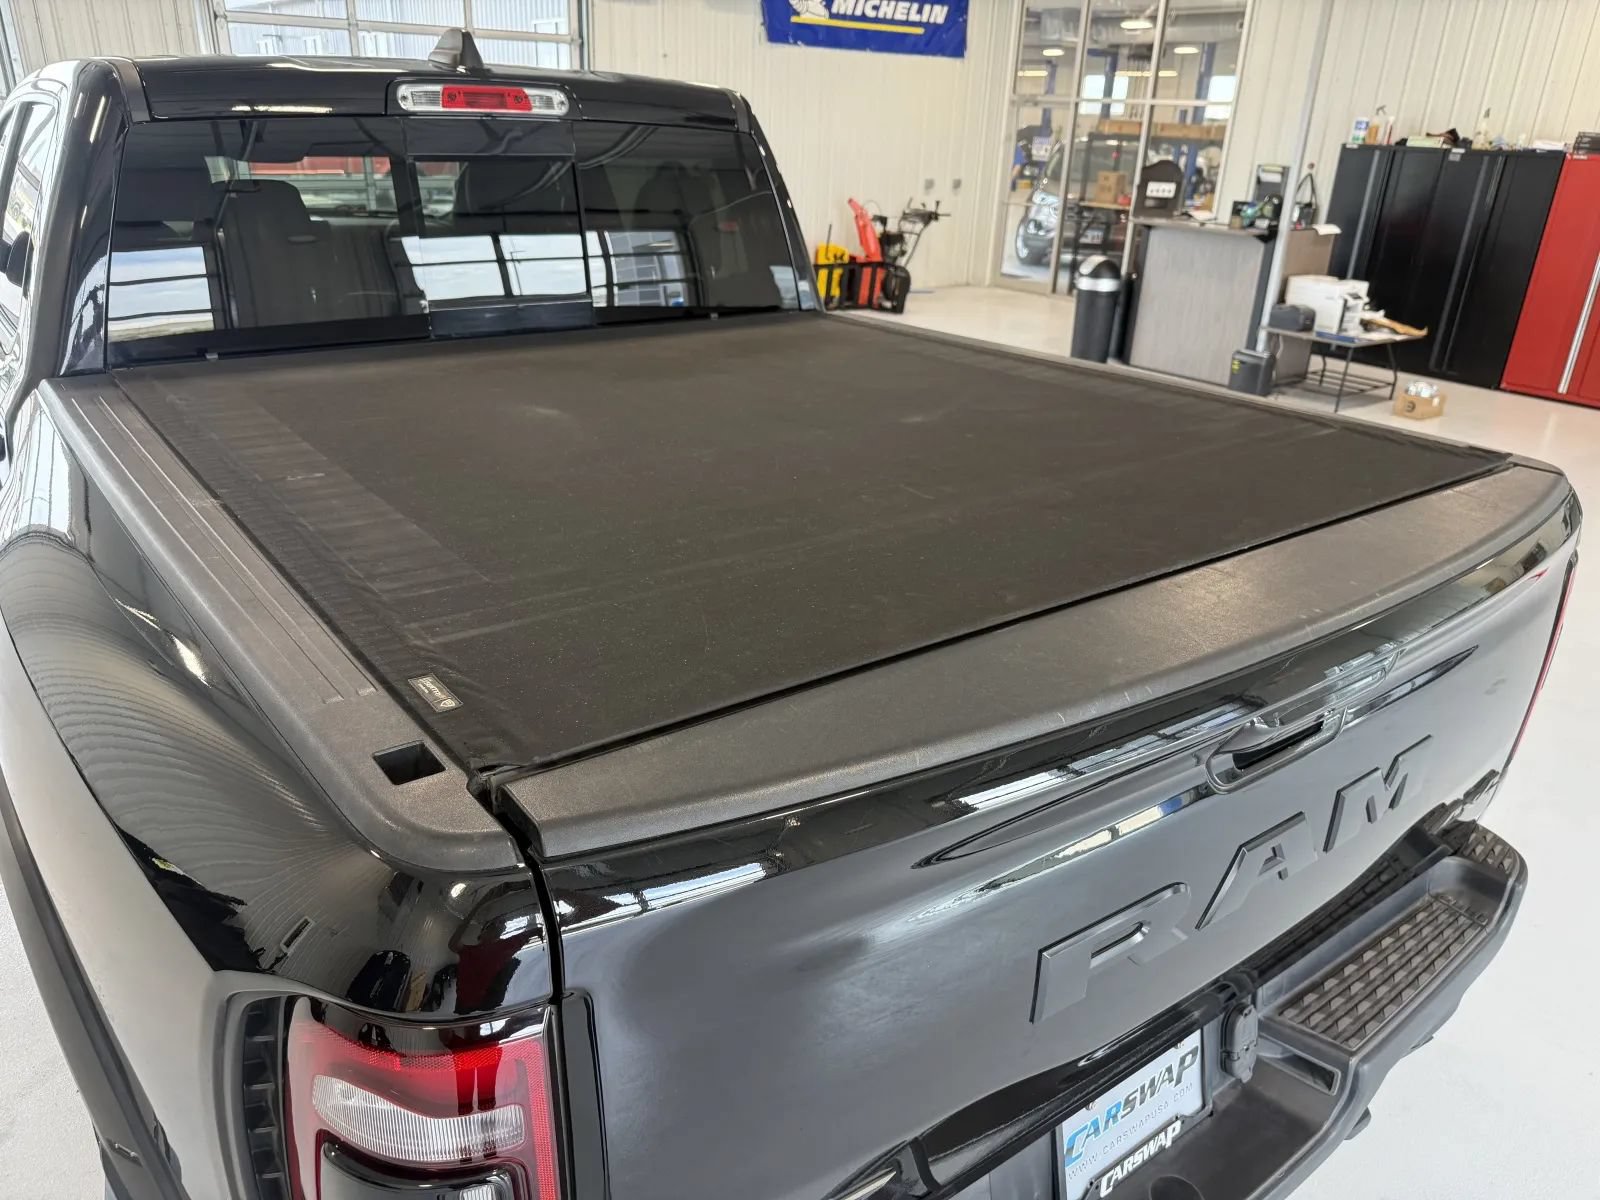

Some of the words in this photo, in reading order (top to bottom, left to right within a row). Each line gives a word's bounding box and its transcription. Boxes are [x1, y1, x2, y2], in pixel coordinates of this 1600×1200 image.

[831, 0, 949, 24] MICHELIN
[1029, 734, 1432, 1024] RAM
[1064, 1045, 1199, 1168] CARSWAP
[1099, 1119, 1182, 1198] CARSWAP
